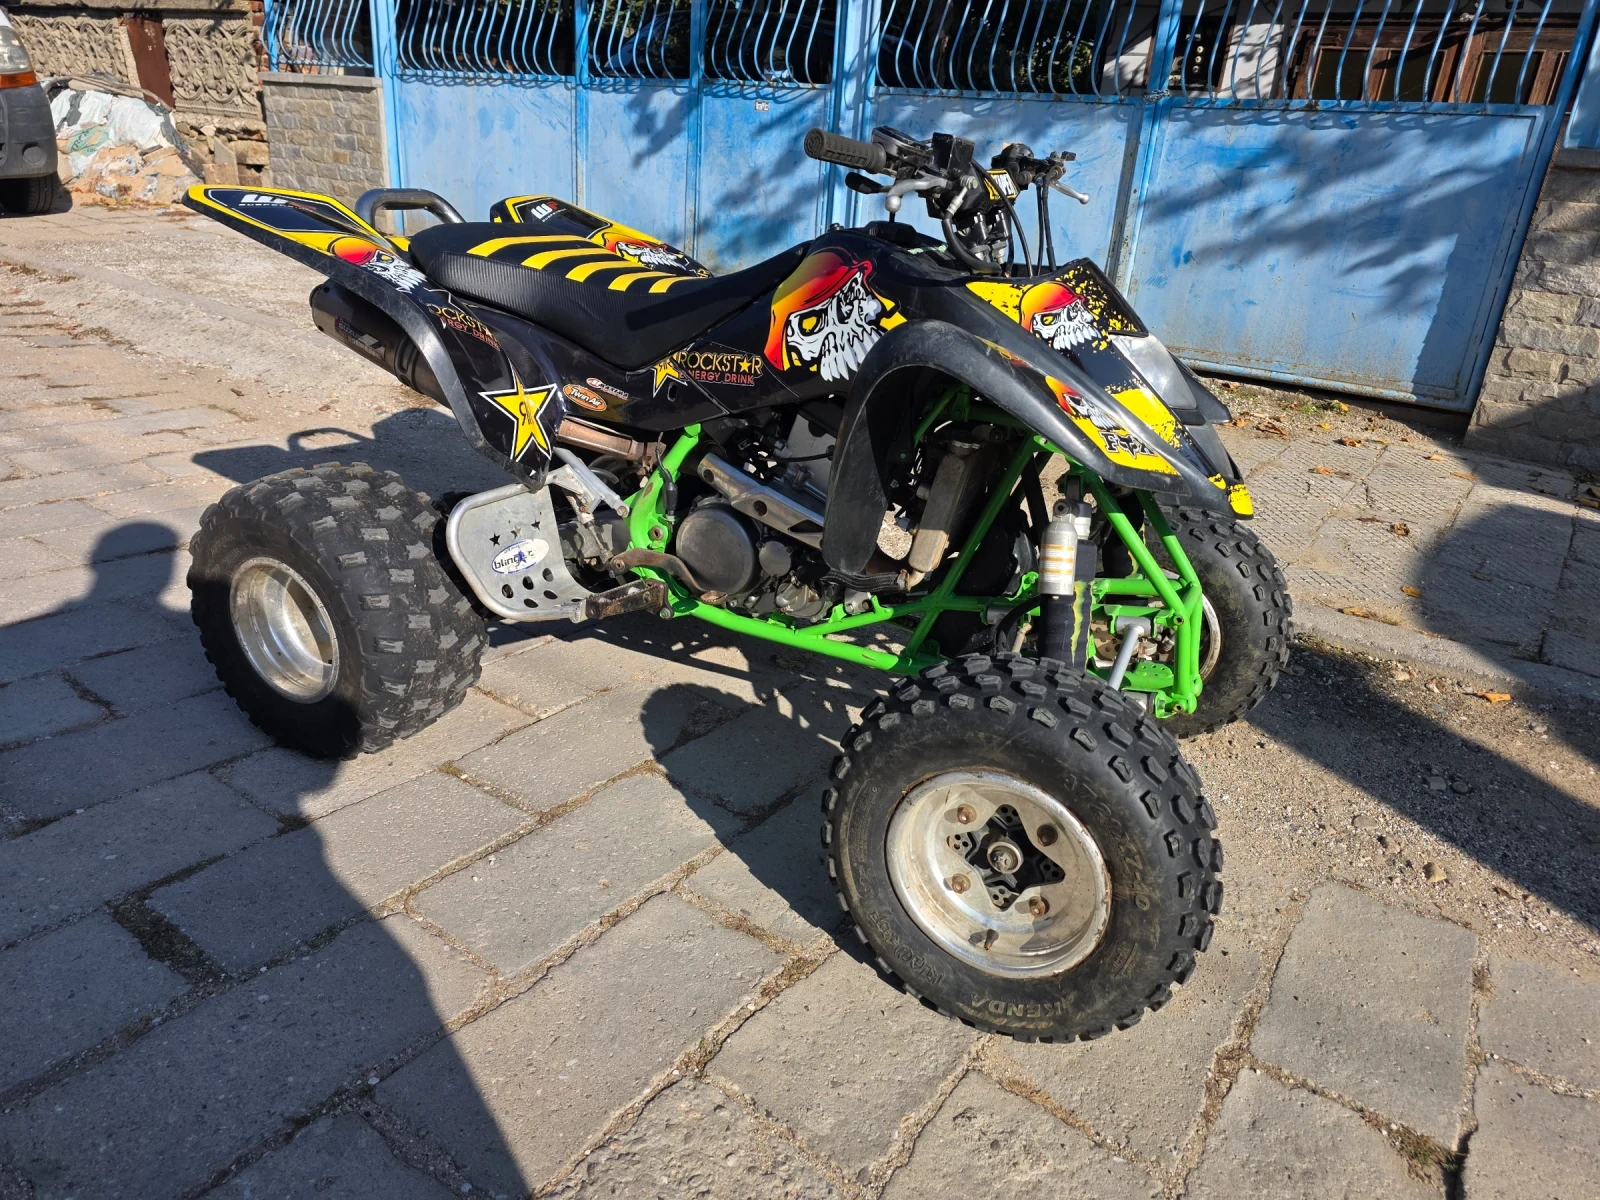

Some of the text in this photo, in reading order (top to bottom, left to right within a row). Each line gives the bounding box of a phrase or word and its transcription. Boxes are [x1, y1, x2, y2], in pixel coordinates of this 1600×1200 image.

[724, 373, 755, 385] DRINK
[569, 387, 590, 403] Twin
[588, 397, 602, 407] Air
[969, 991, 1063, 1019] KENDA
